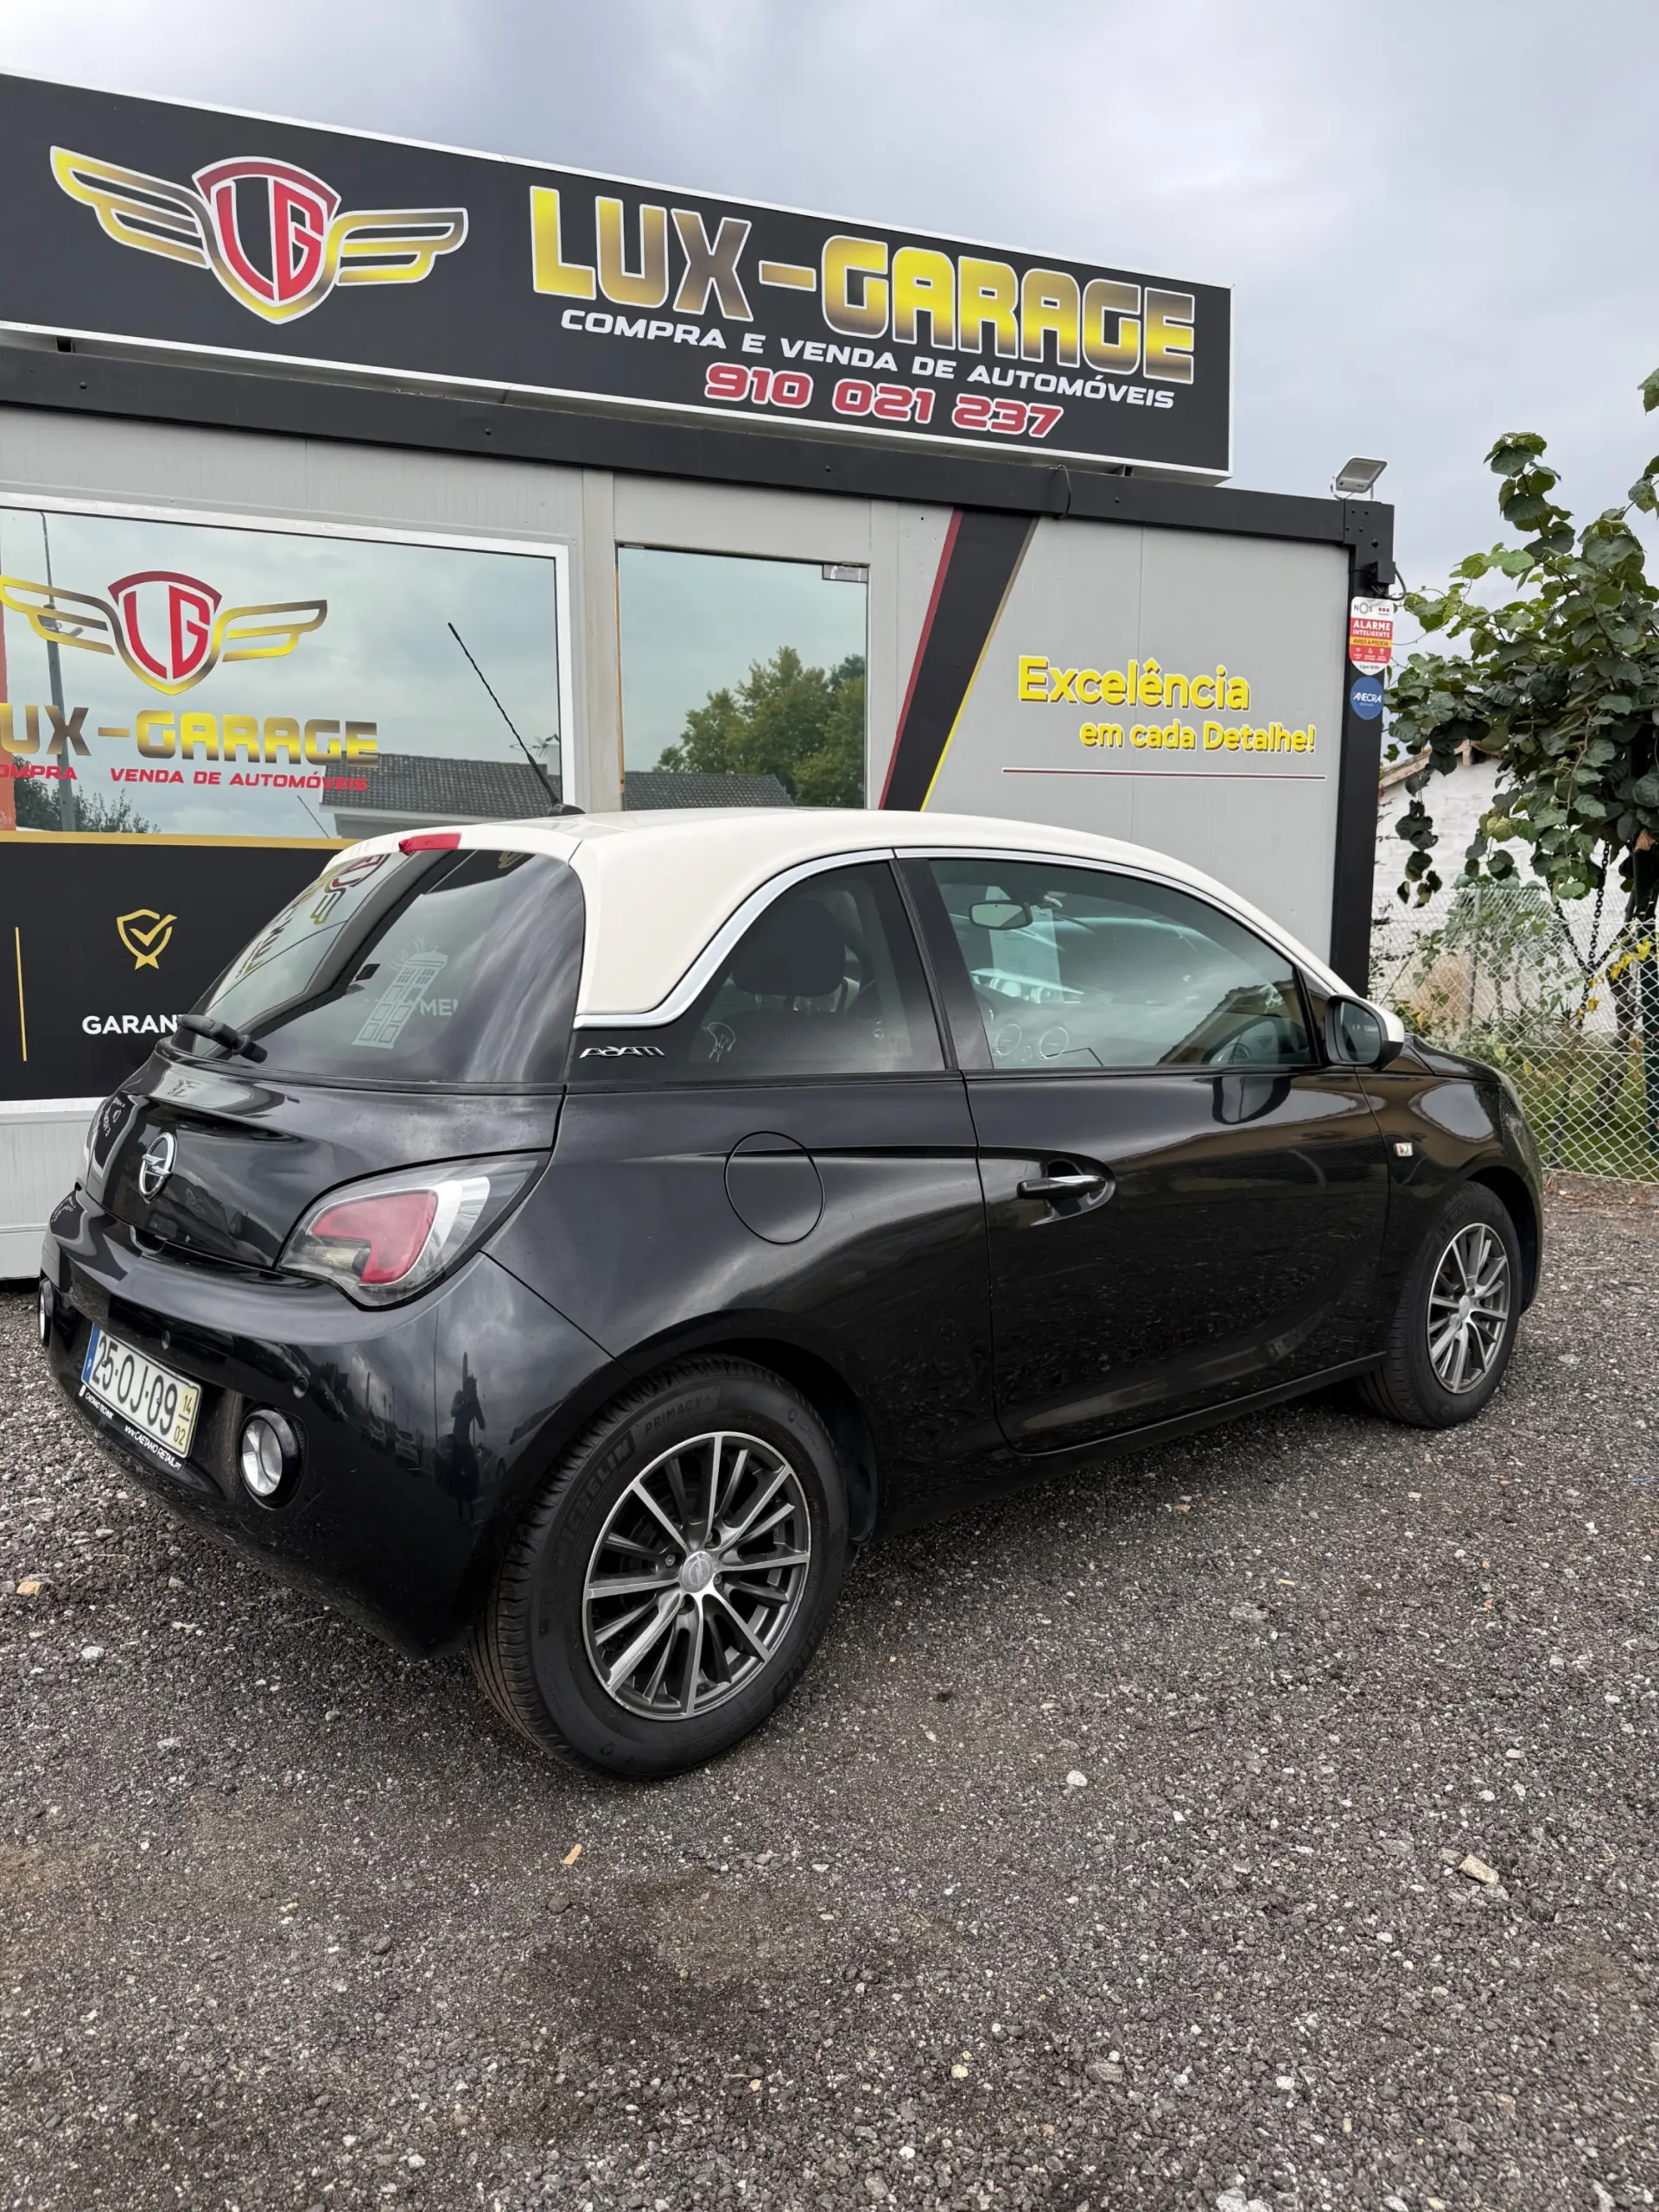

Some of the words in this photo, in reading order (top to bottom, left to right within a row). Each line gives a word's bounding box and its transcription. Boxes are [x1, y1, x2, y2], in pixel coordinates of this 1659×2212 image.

[530, 185, 1196, 385] LUX-GARAGE
[561, 309, 728, 351] COMPRA
[742, 333, 766, 355] E
[779, 338, 899, 372] VENDA
[911, 357, 956, 380] DE
[974, 365, 1175, 410] AUTOMÓVEIS
[705, 363, 814, 410] 910
[832, 380, 933, 425] 021
[951, 395, 1064, 438] 237
[1352, 629, 1390, 639] INTELIGENTE
[1353, 620, 1391, 632] ALARME
[1018, 656, 1250, 711] Excelência
[1353, 692, 1382, 703] ANECRA
[1079, 723, 1123, 748] em
[1129, 720, 1196, 750] cada
[1203, 721, 1316, 754] Detalhe!
[111, 768, 183, 784] VENDA
[193, 772, 222, 785] DE
[229, 771, 368, 791] AUTOMÓVEIS
[82, 1014, 188, 1034] GARAN
[182, 1395, 192, 1414] 14
[645, 1395, 702, 1434] PRIMACY
[174, 1426, 187, 1446] 02
